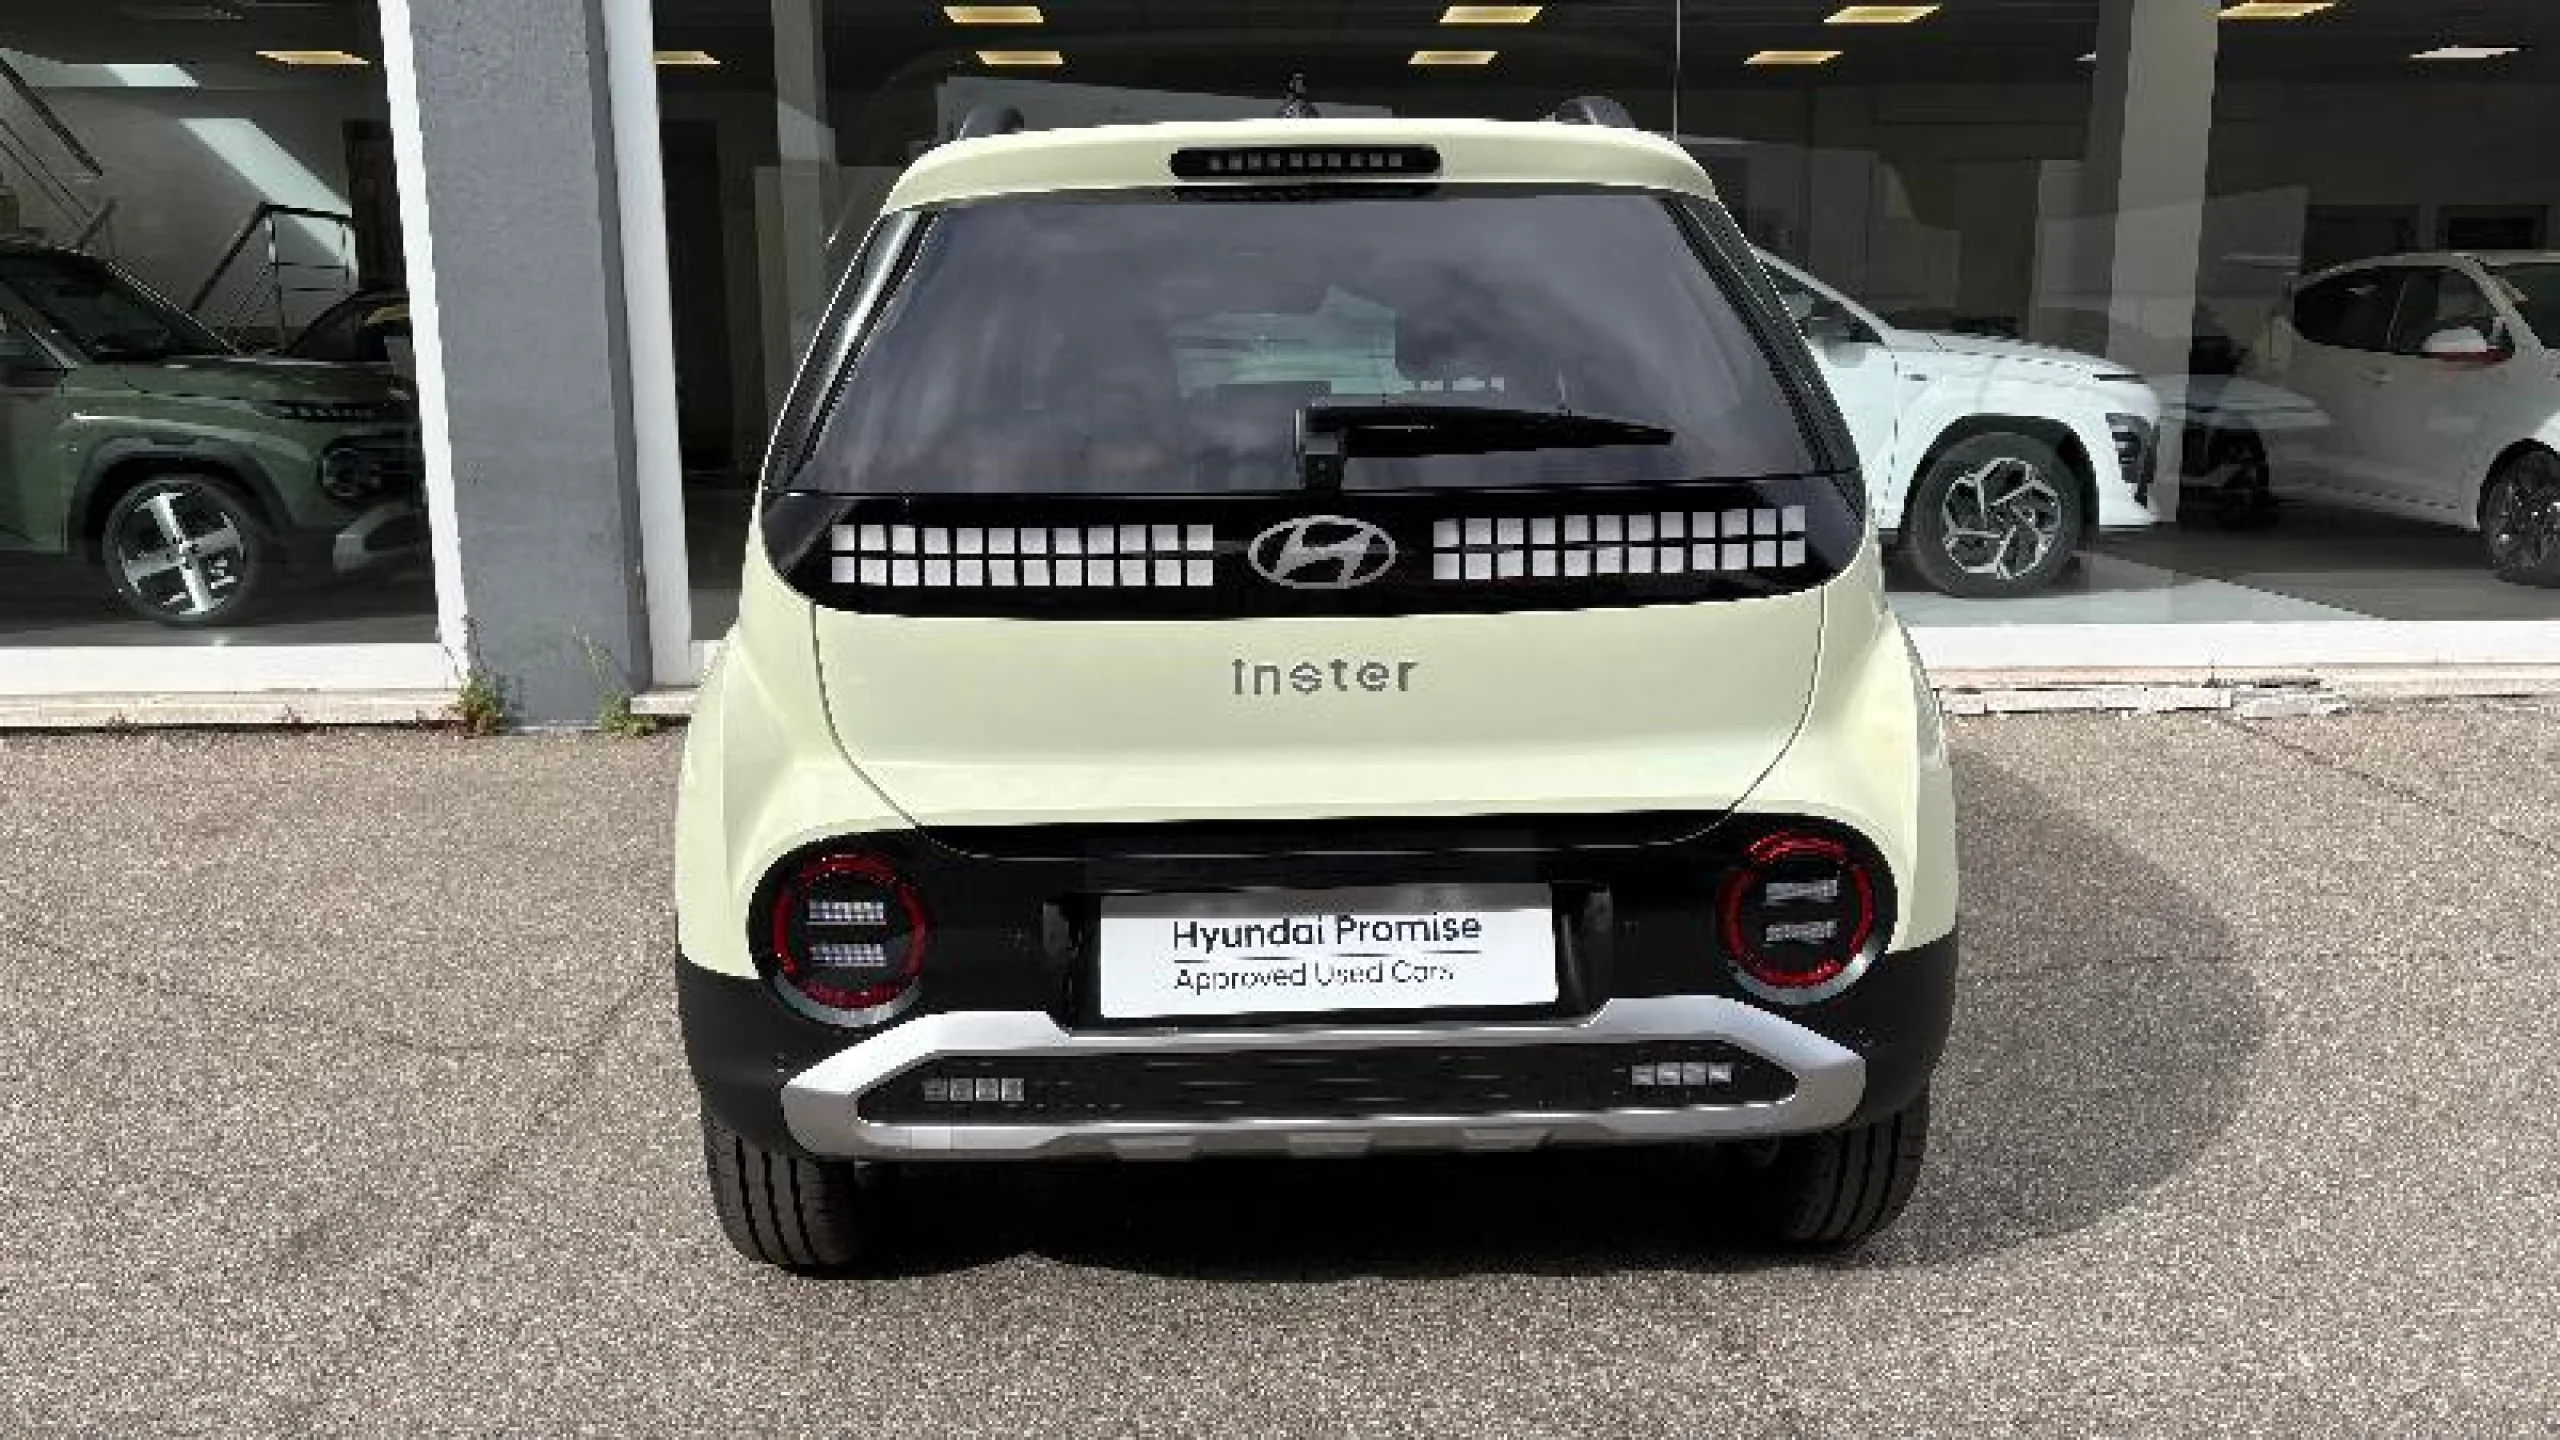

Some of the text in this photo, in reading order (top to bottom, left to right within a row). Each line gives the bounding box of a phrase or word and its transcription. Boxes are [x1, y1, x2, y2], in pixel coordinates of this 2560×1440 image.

[1232, 659, 1418, 694] inster
[1173, 911, 1483, 954] Hyundai Promise
[1174, 959, 1454, 996] Approved Used Cars
